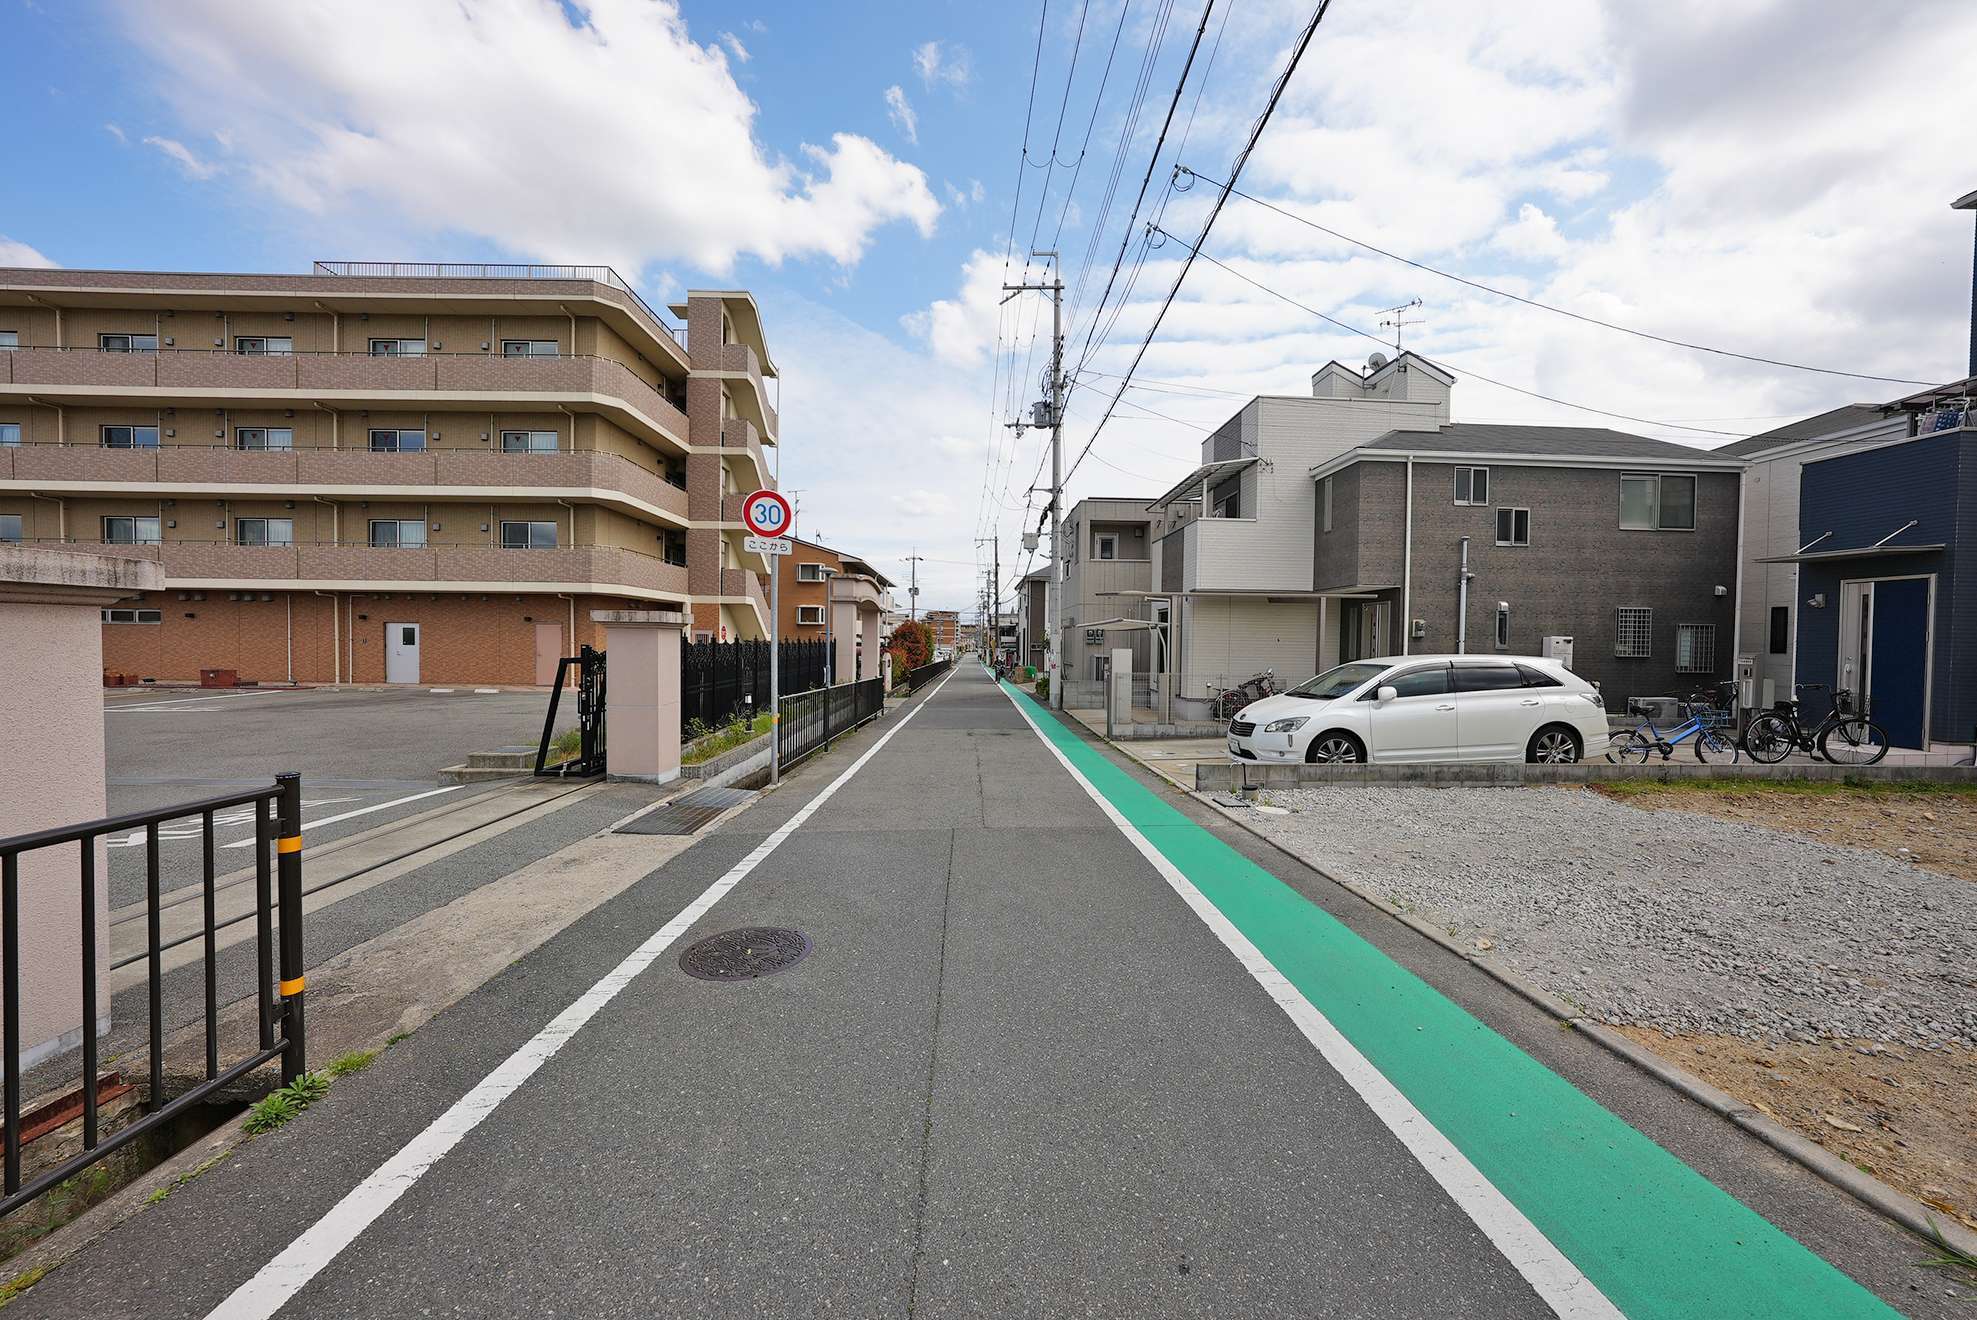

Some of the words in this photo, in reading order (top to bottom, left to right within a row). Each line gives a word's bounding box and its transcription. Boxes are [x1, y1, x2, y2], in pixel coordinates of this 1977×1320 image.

[755, 504, 781, 525] 30
[748, 540, 788, 552] ここから
